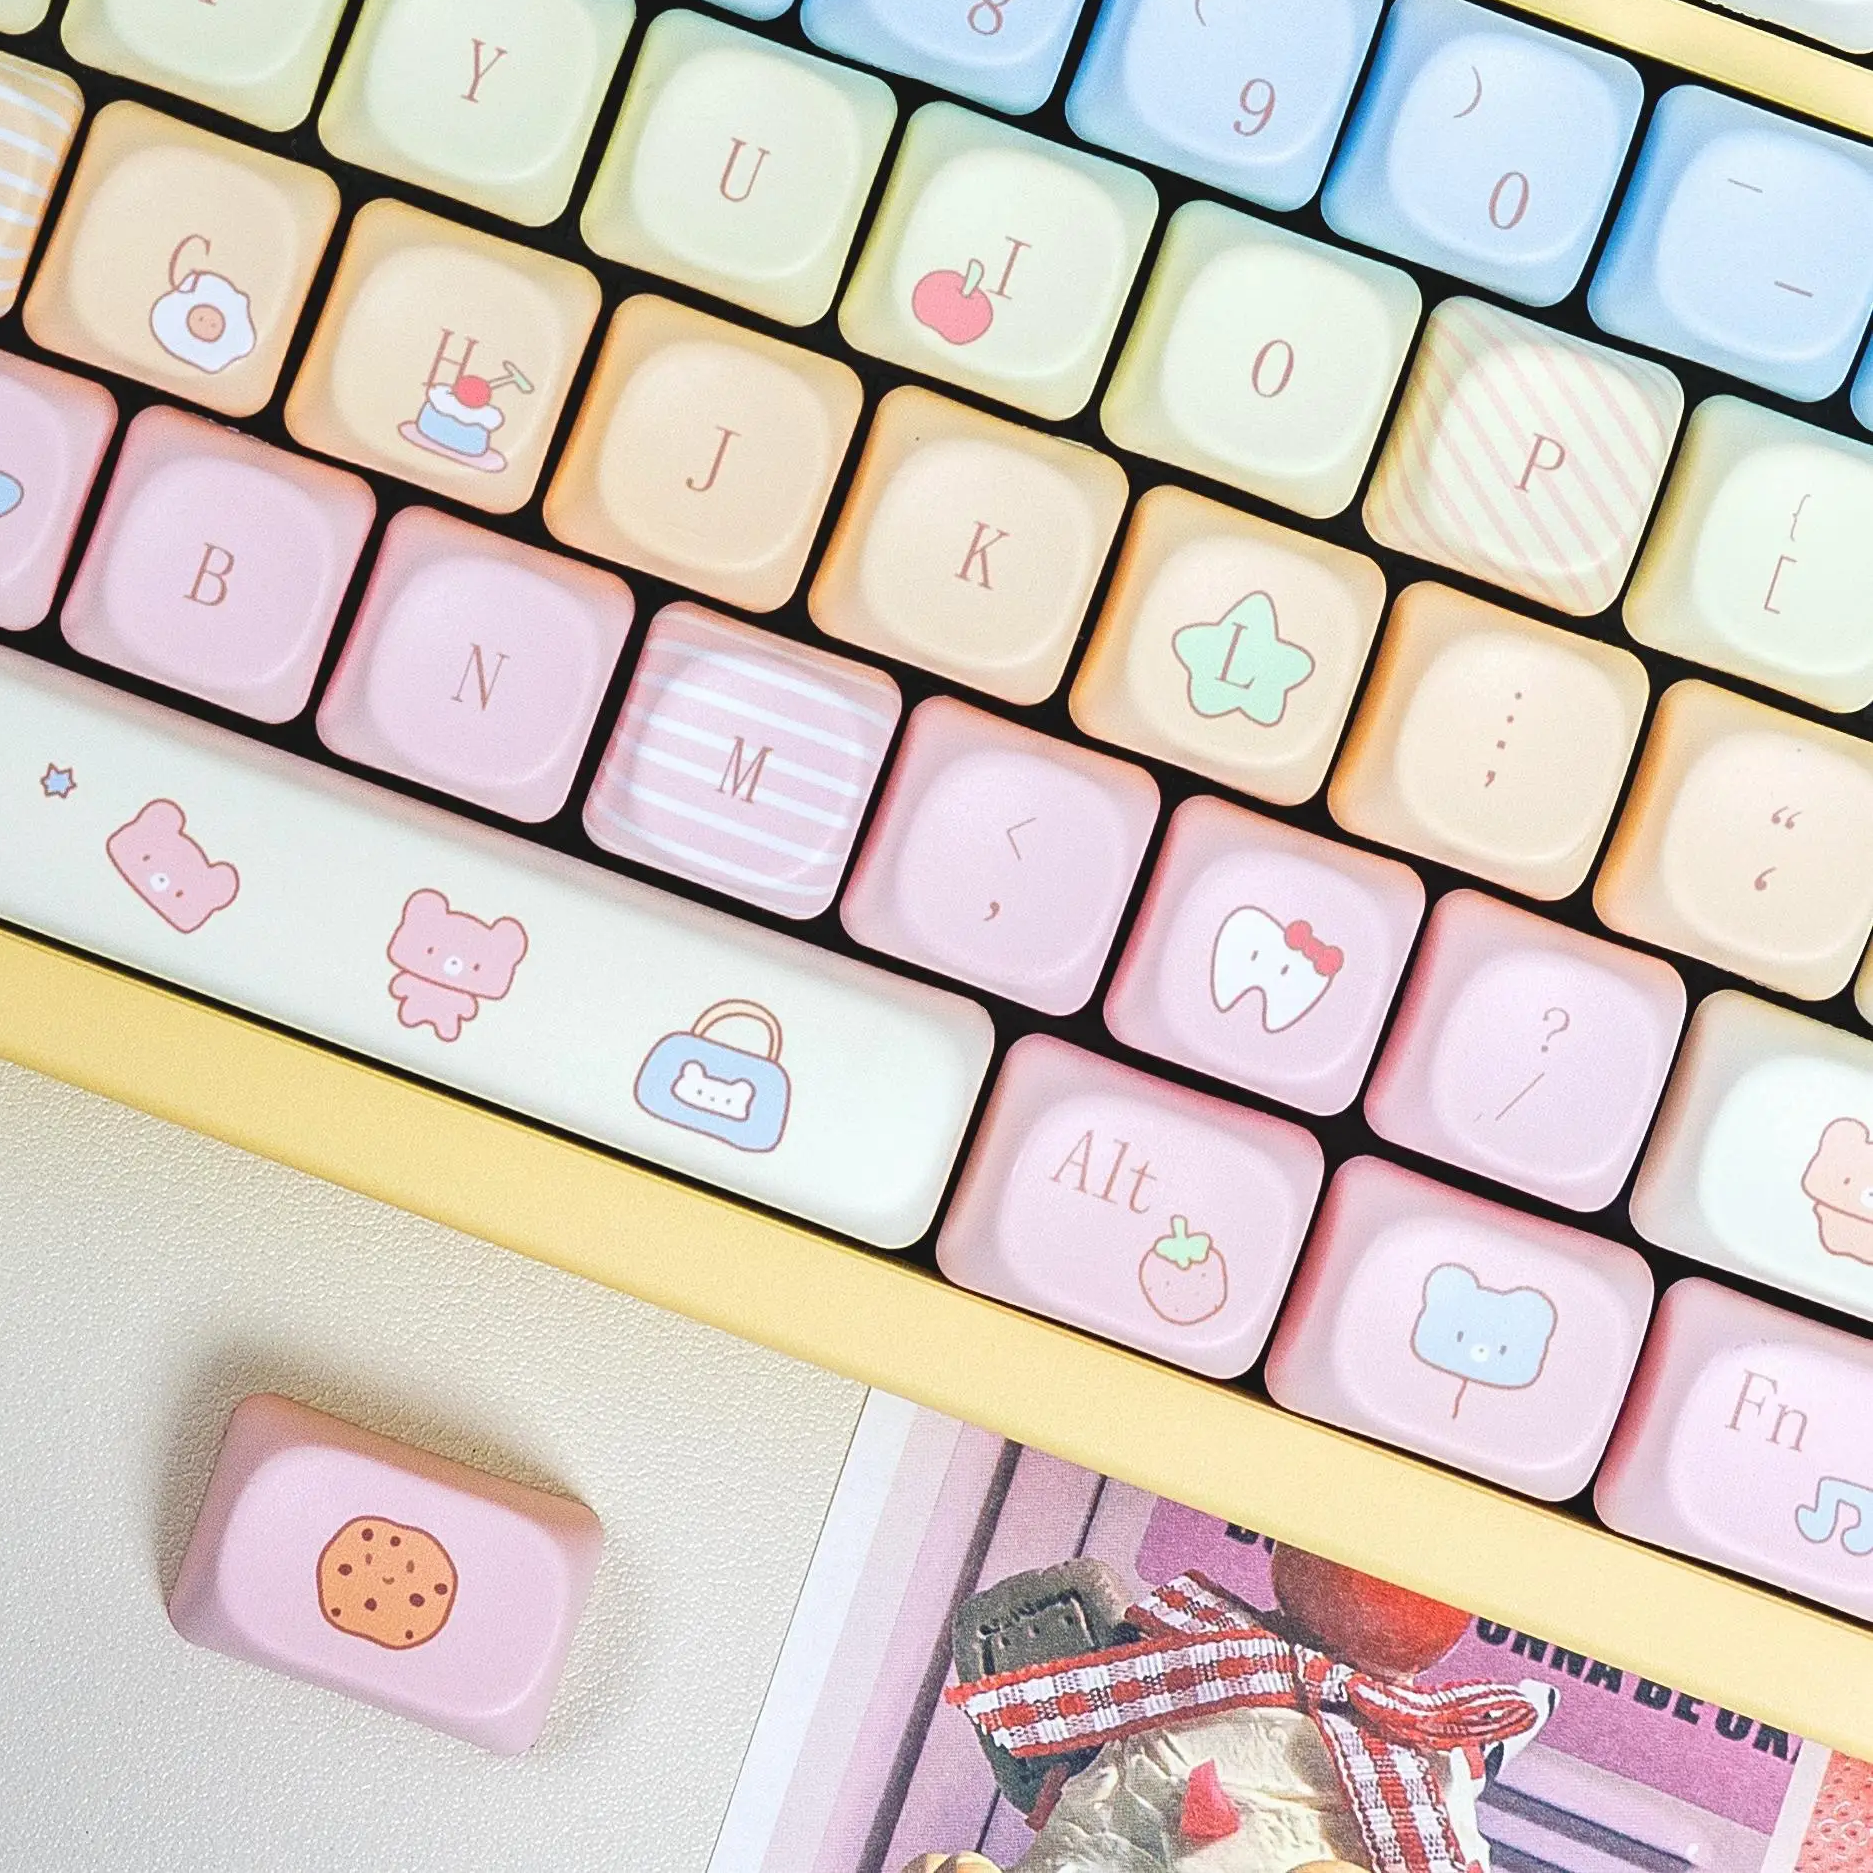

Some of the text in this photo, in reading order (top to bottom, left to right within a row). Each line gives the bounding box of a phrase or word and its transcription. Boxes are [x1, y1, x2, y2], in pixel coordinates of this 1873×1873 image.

[461, 38, 507, 103] Y
[1232, 78, 1276, 136] 9
[718, 137, 770, 203] U
[169, 234, 210, 293] G
[987, 237, 1032, 300] I
[422, 328, 479, 396] H
[1251, 339, 1294, 398] O
[686, 426, 741, 493] J
[1514, 433, 1565, 492] P
[183, 542, 234, 609] B
[954, 521, 1010, 592] K
[450, 642, 509, 713] N
[1214, 623, 1255, 690] L
[717, 735, 773, 806] M
[1541, 1007, 1571, 1054] ?
[1051, 1129, 1157, 1215] Alt
[1725, 1369, 1812, 1455] Fn
